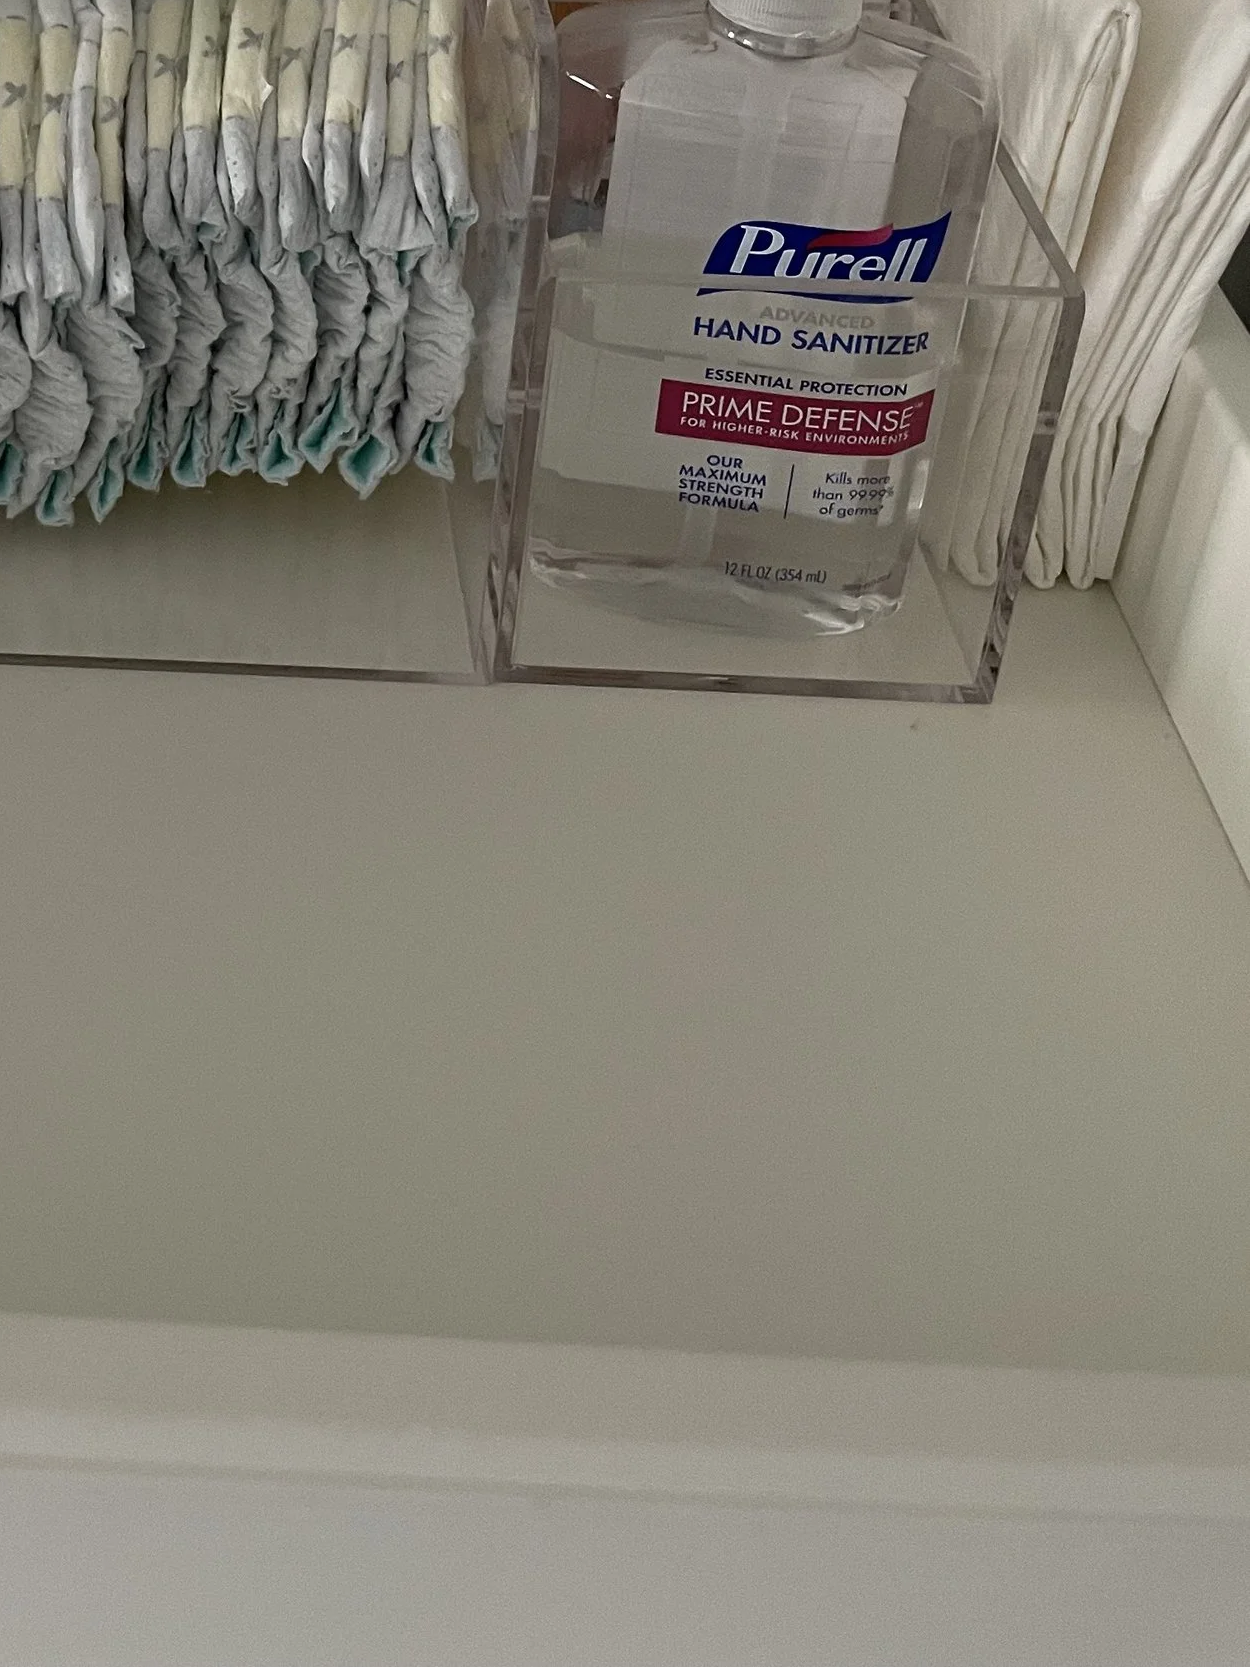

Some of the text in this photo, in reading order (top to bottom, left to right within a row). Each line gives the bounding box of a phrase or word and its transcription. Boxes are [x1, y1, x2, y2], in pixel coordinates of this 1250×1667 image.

[729, 224, 928, 283] Purell
[759, 305, 876, 330] ADVANCED
[693, 316, 930, 356] HAND SANITIZER
[704, 367, 908, 397] ESSENTIAL PROTECTION
[682, 391, 774, 424] PRIME
[680, 416, 909, 447] FOR HIGHER-RISK ENVIRONMENTS
[706, 454, 743, 470] OUR
[678, 464, 767, 486] MAXIMUM
[825, 472, 891, 485] Kills more
[678, 478, 764, 500] STRENGTH
[812, 487, 843, 501] than
[678, 491, 759, 513] FORMULA
[818, 502, 835, 516] of
[724, 561, 738, 576] 12
[740, 563, 753, 578] FL
[756, 565, 772, 580] OZ
[775, 568, 803, 583] (354
[805, 570, 827, 584] mL)
